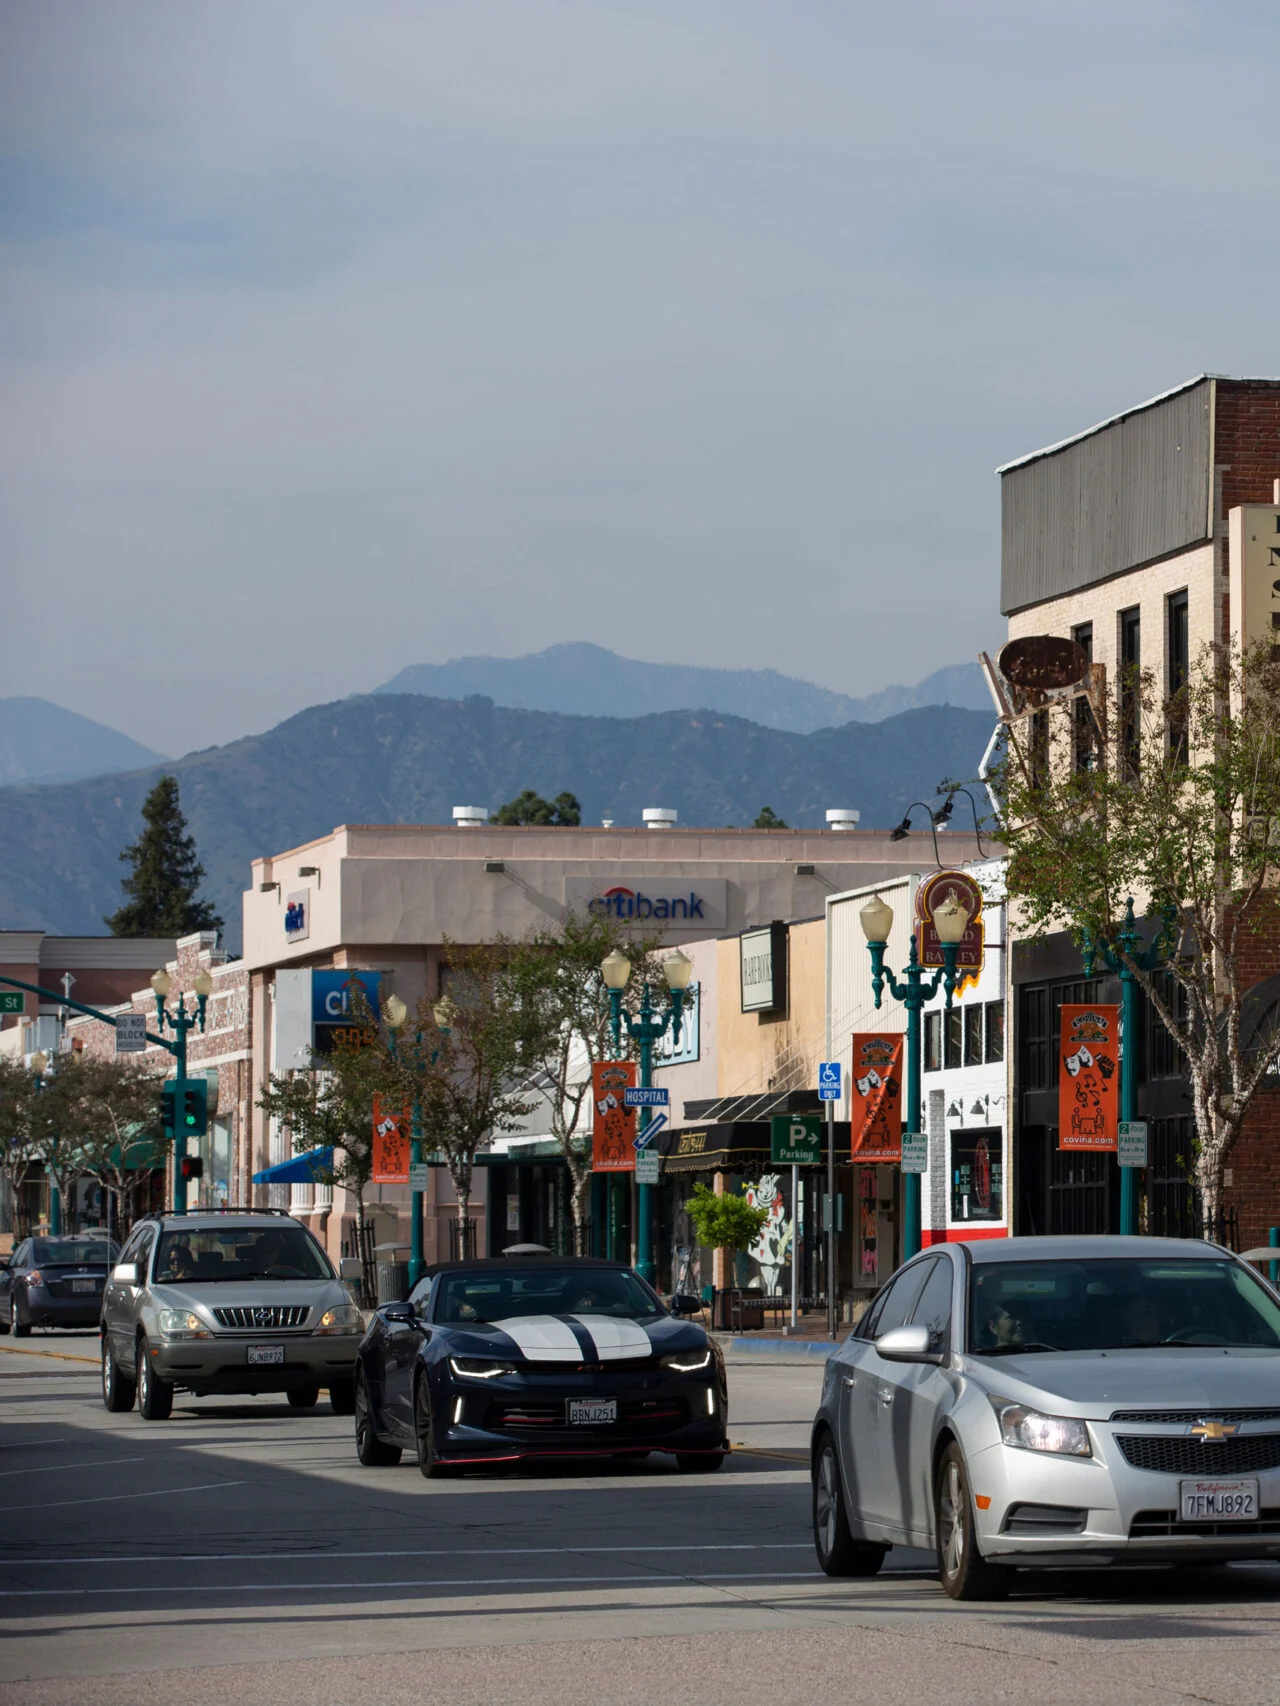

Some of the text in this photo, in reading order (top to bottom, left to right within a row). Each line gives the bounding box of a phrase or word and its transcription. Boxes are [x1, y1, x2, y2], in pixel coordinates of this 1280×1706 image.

[588, 892, 704, 919] citibank
[5, 998, 18, 1009] St
[119, 1031, 145, 1040] BLOCK
[626, 1091, 667, 1103] HOSPITAL
[1121, 1124, 1127, 1135] 2
[905, 1135, 911, 1144] 2
[1064, 1135, 1113, 1145] covina.com
[780, 1149, 814, 1161] Parking
[1187, 1495, 1253, 1514] 7FMJ892
